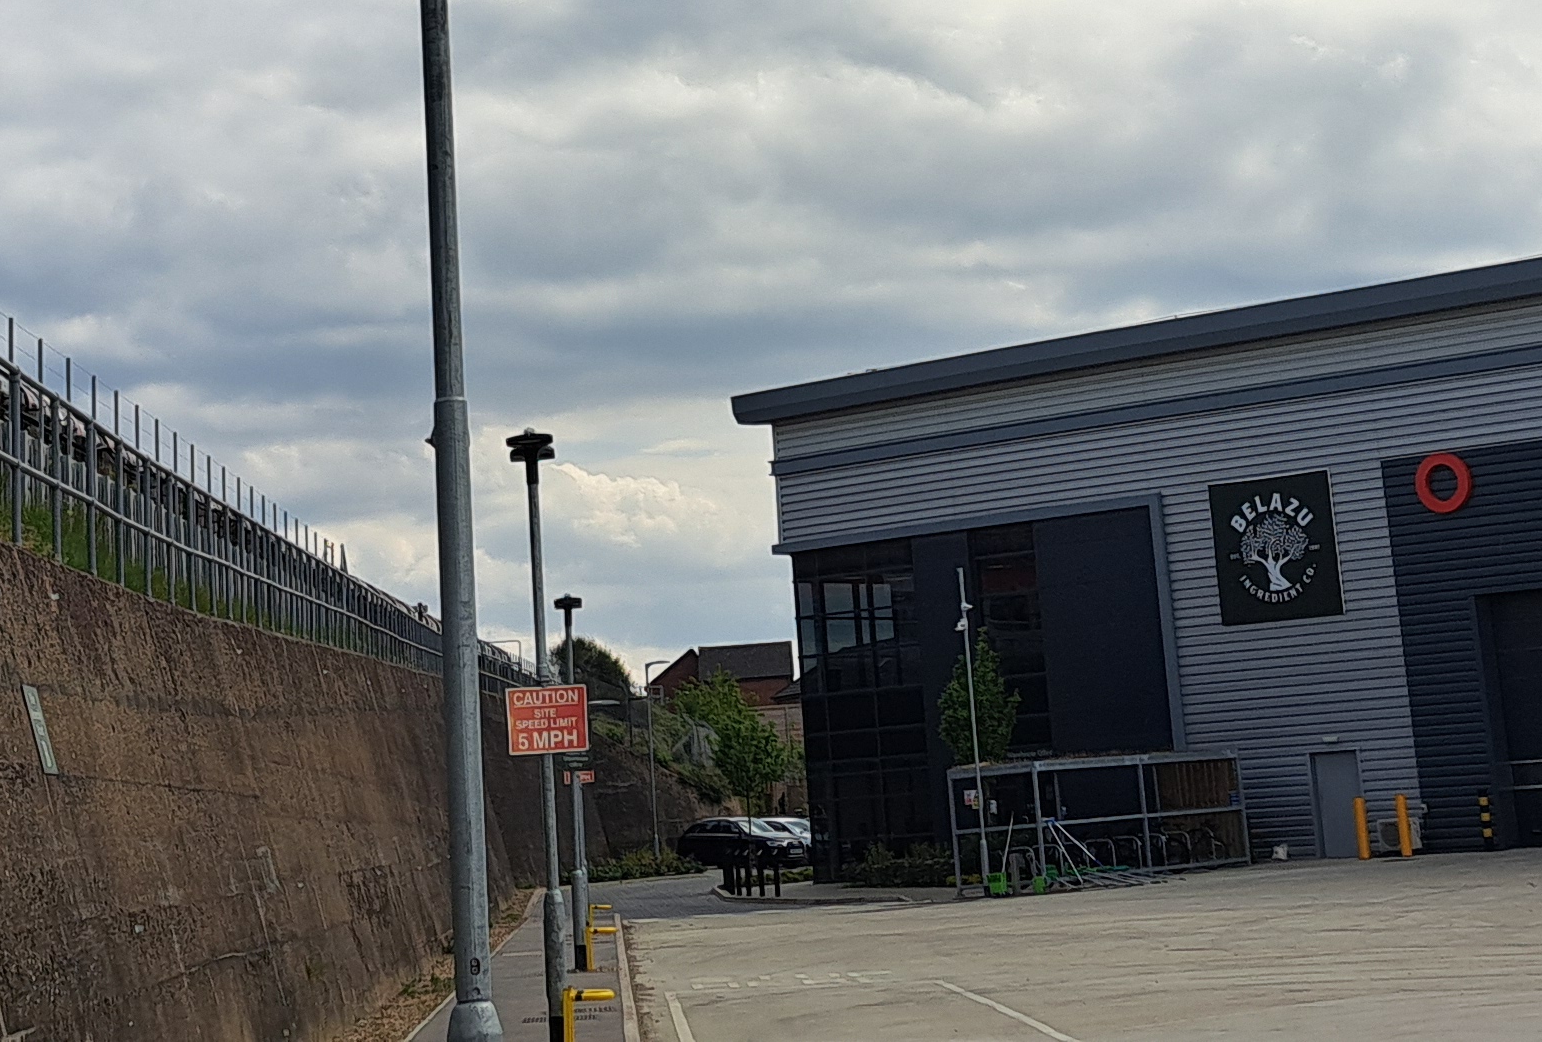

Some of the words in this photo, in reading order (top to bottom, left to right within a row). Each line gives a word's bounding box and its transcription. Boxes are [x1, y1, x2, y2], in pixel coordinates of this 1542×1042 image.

[1230, 493, 1314, 533] BELAZU
[1239, 574, 1303, 603] INGREDIENT
[1302, 562, 1317, 584] CO.
[513, 689, 578, 705] CAUTION
[534, 708, 557, 718] SITE
[515, 719, 548, 729] SPEED
[550, 717, 578, 728] LIMIT
[532, 729, 578, 749] MPH
